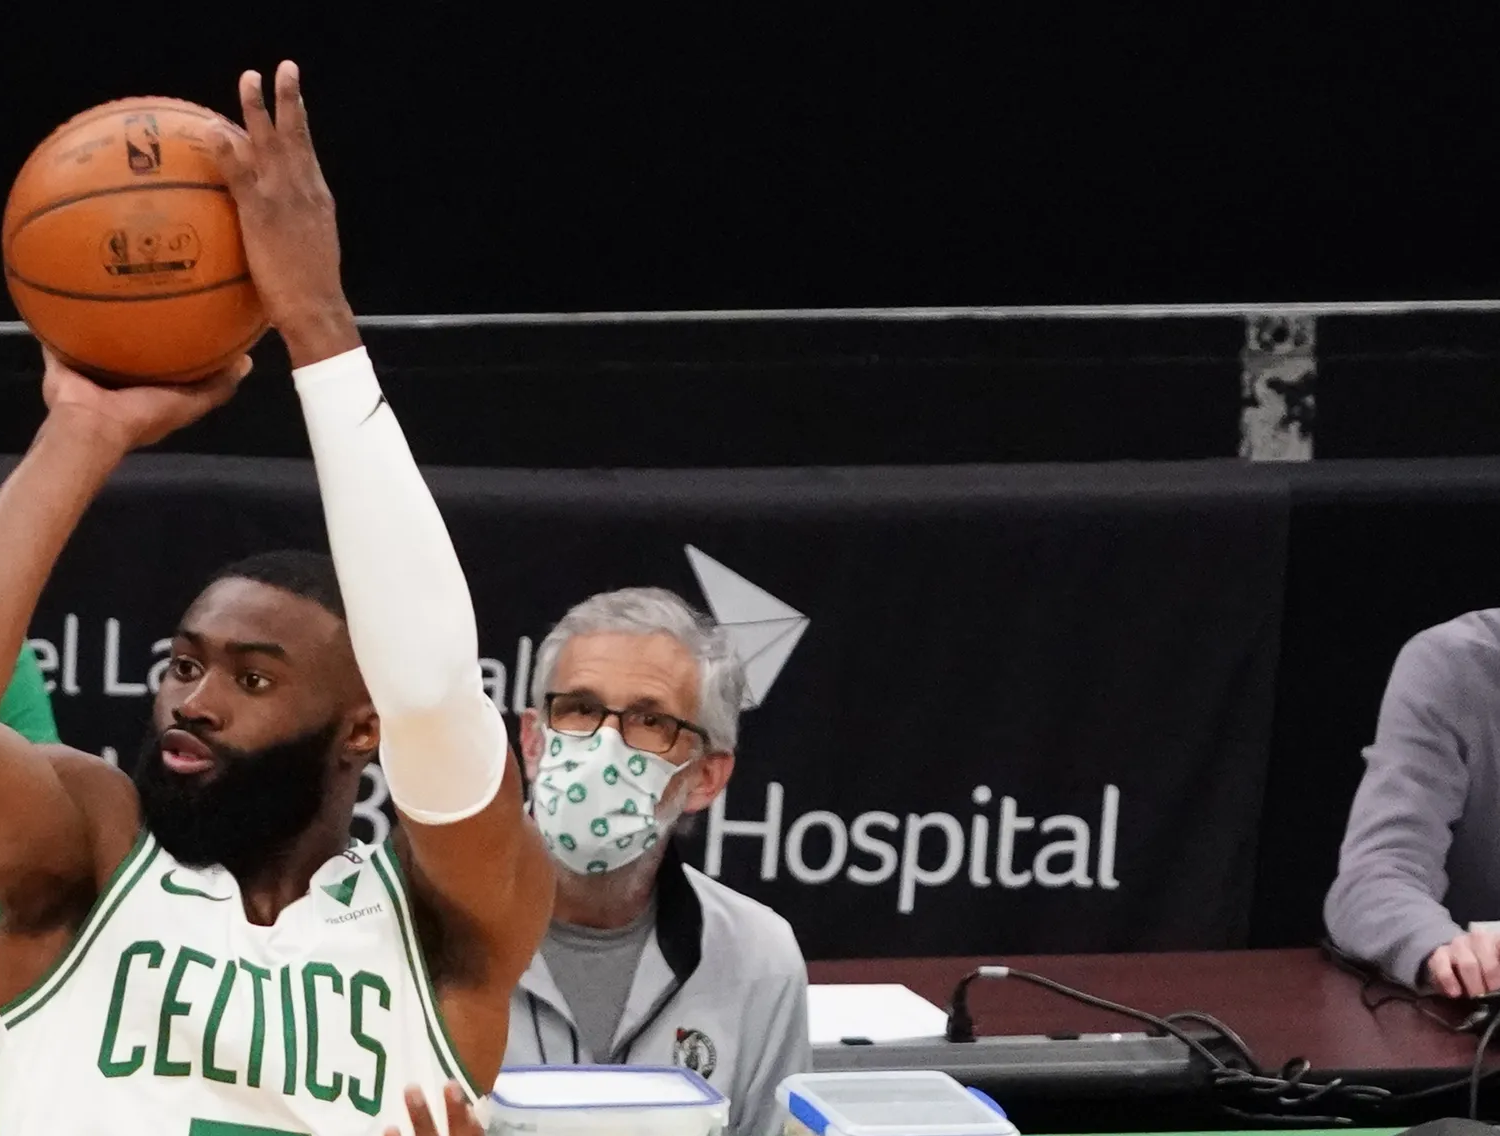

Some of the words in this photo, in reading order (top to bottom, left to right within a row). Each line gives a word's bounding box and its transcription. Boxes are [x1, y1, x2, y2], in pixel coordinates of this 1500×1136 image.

[27, 613, 81, 696] el
[477, 636, 533, 715] al
[704, 778, 1120, 914] Hospital
[97, 940, 391, 1117] CELTICS
